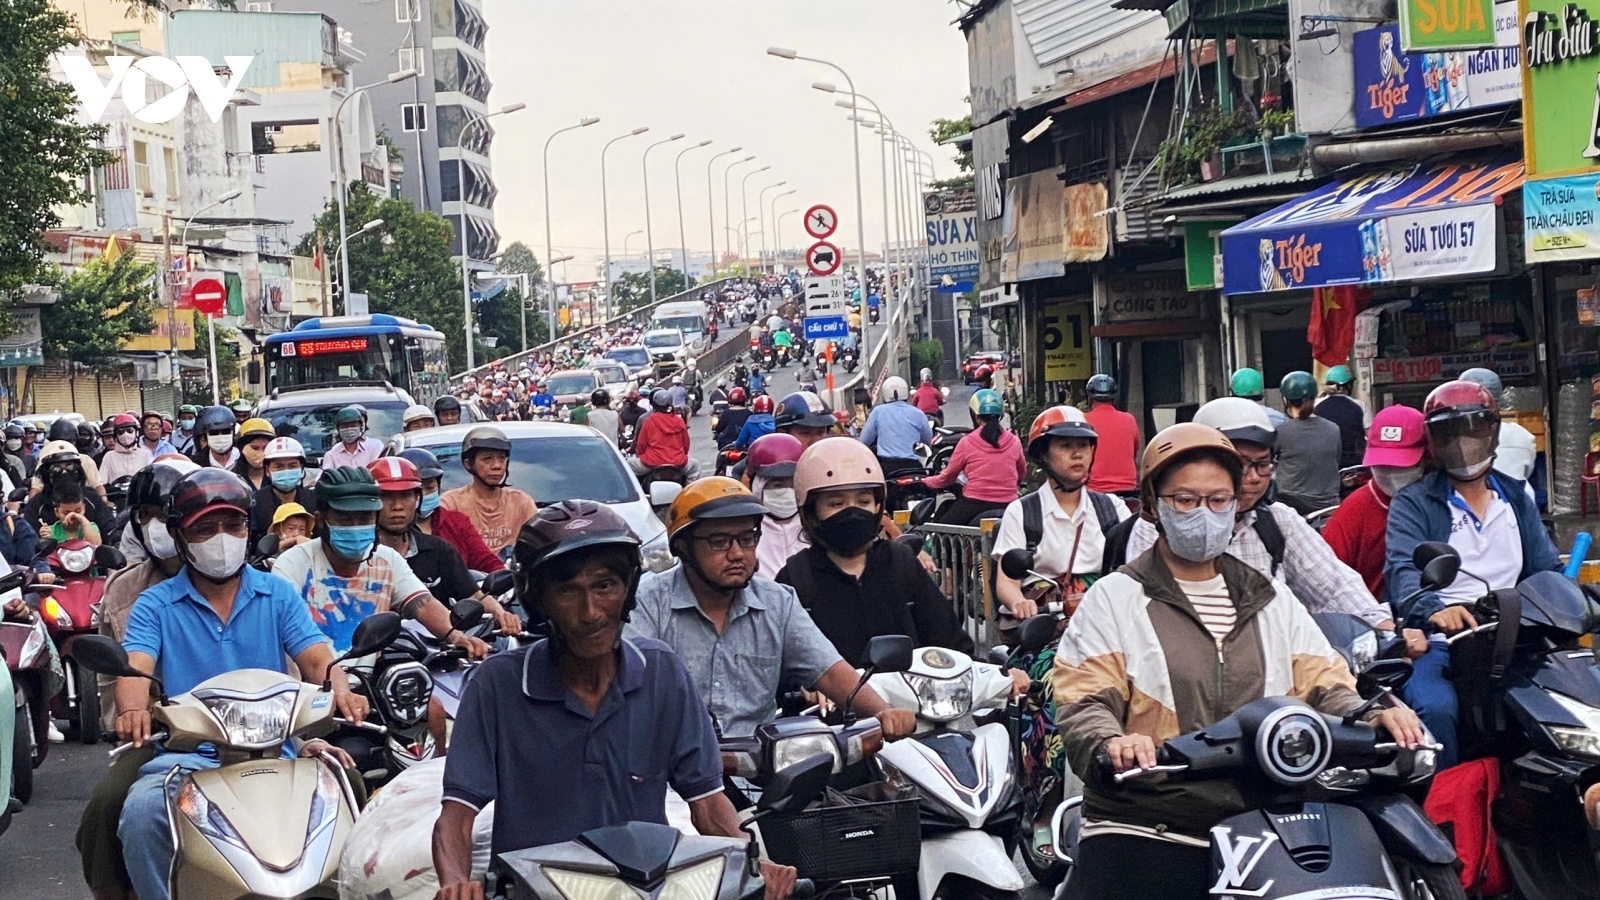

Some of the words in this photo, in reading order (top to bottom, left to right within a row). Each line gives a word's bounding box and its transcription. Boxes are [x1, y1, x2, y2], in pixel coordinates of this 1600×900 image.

[1367, 79, 1410, 119] Tiger
[1558, 185, 1576, 204] SỮA
[926, 214, 961, 246] SỬA
[1549, 208, 1574, 228] CHÂU
[1575, 209, 1594, 226] ĐEN
[1404, 222, 1427, 254] SỮA
[1430, 222, 1457, 252] TƯƠI
[1460, 220, 1475, 248] 57
[1275, 234, 1322, 283] Tiger
[1043, 314, 1083, 350] 51
[283, 344, 294, 355] 68
[1277, 813, 1321, 824] VINFAST
[845, 829, 875, 839] HONDA
